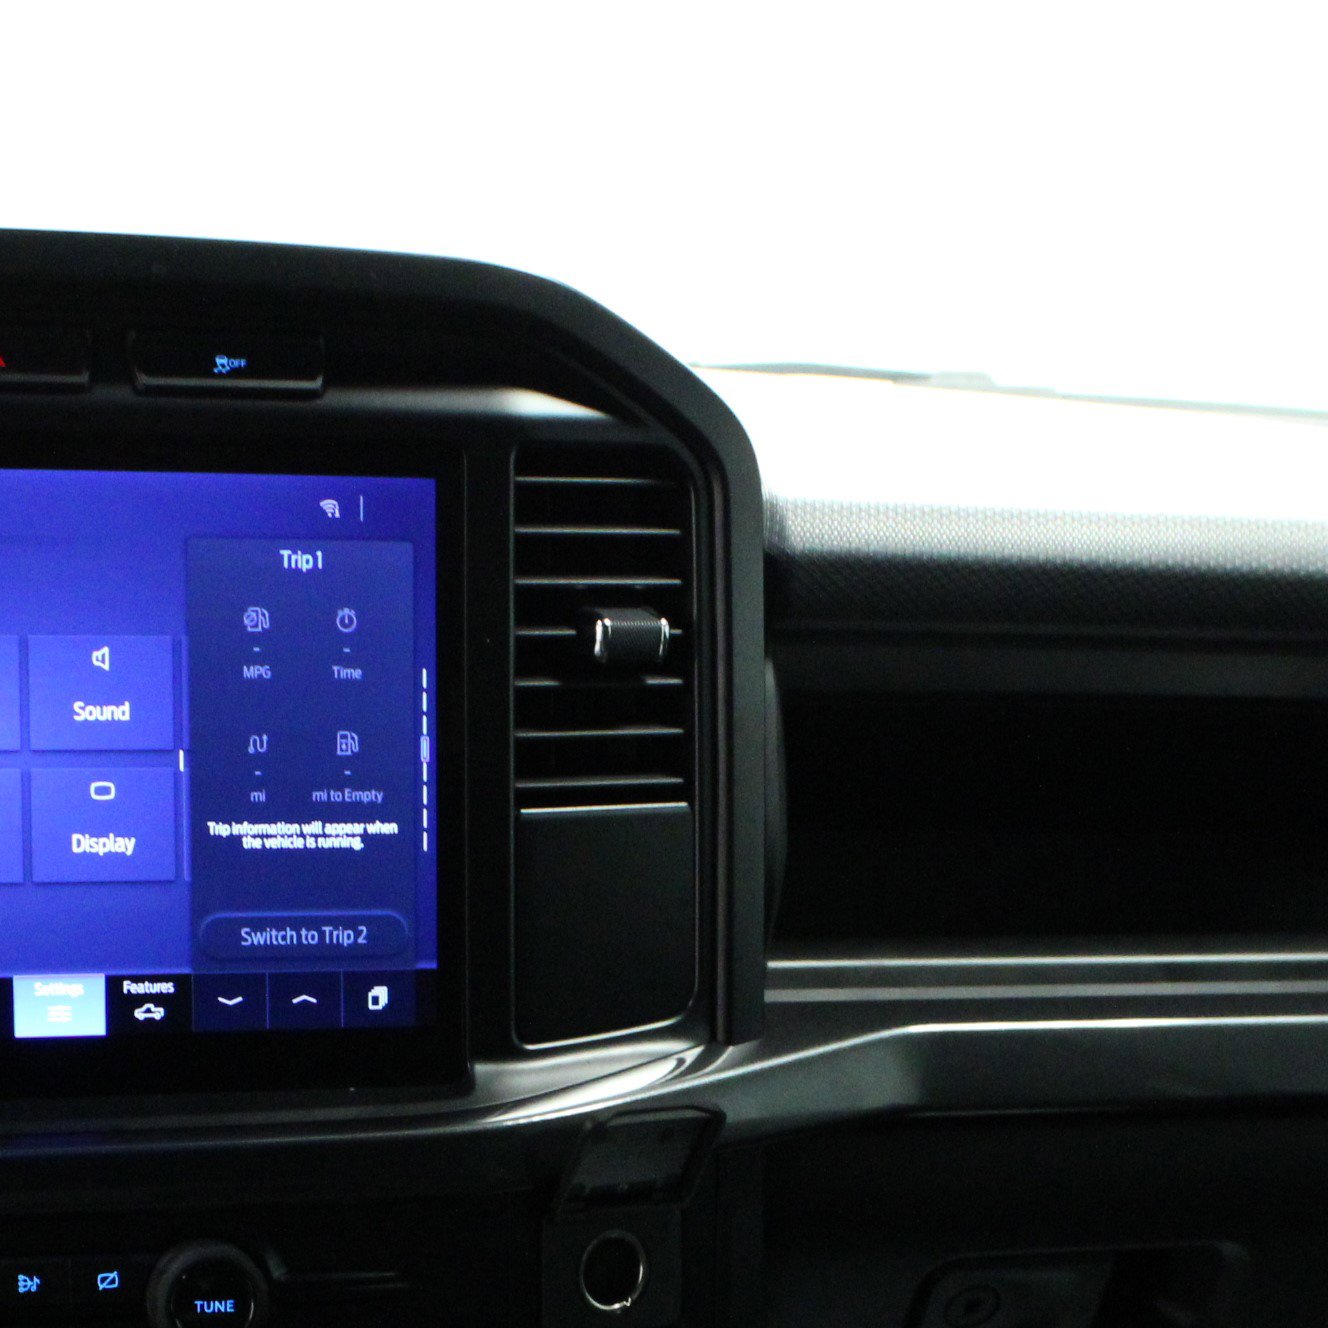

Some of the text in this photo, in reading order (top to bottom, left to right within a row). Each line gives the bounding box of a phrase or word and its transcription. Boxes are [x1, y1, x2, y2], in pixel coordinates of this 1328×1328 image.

[229, 359, 247, 368] OFF
[280, 550, 323, 572] Trip 1
[243, 666, 271, 680] MPG
[332, 666, 362, 680] Time
[73, 702, 130, 721] Sound
[250, 789, 266, 803] mi
[312, 789, 383, 804] mi to Empty
[207, 821, 398, 837] Trip information will appear when
[72, 834, 135, 857] Display
[242, 836, 364, 851] the vehicle is running.
[241, 926, 367, 947] Switch to Trip 2
[34, 981, 84, 997] Settings
[123, 980, 174, 995] Features
[194, 1299, 234, 1313] TUNE
